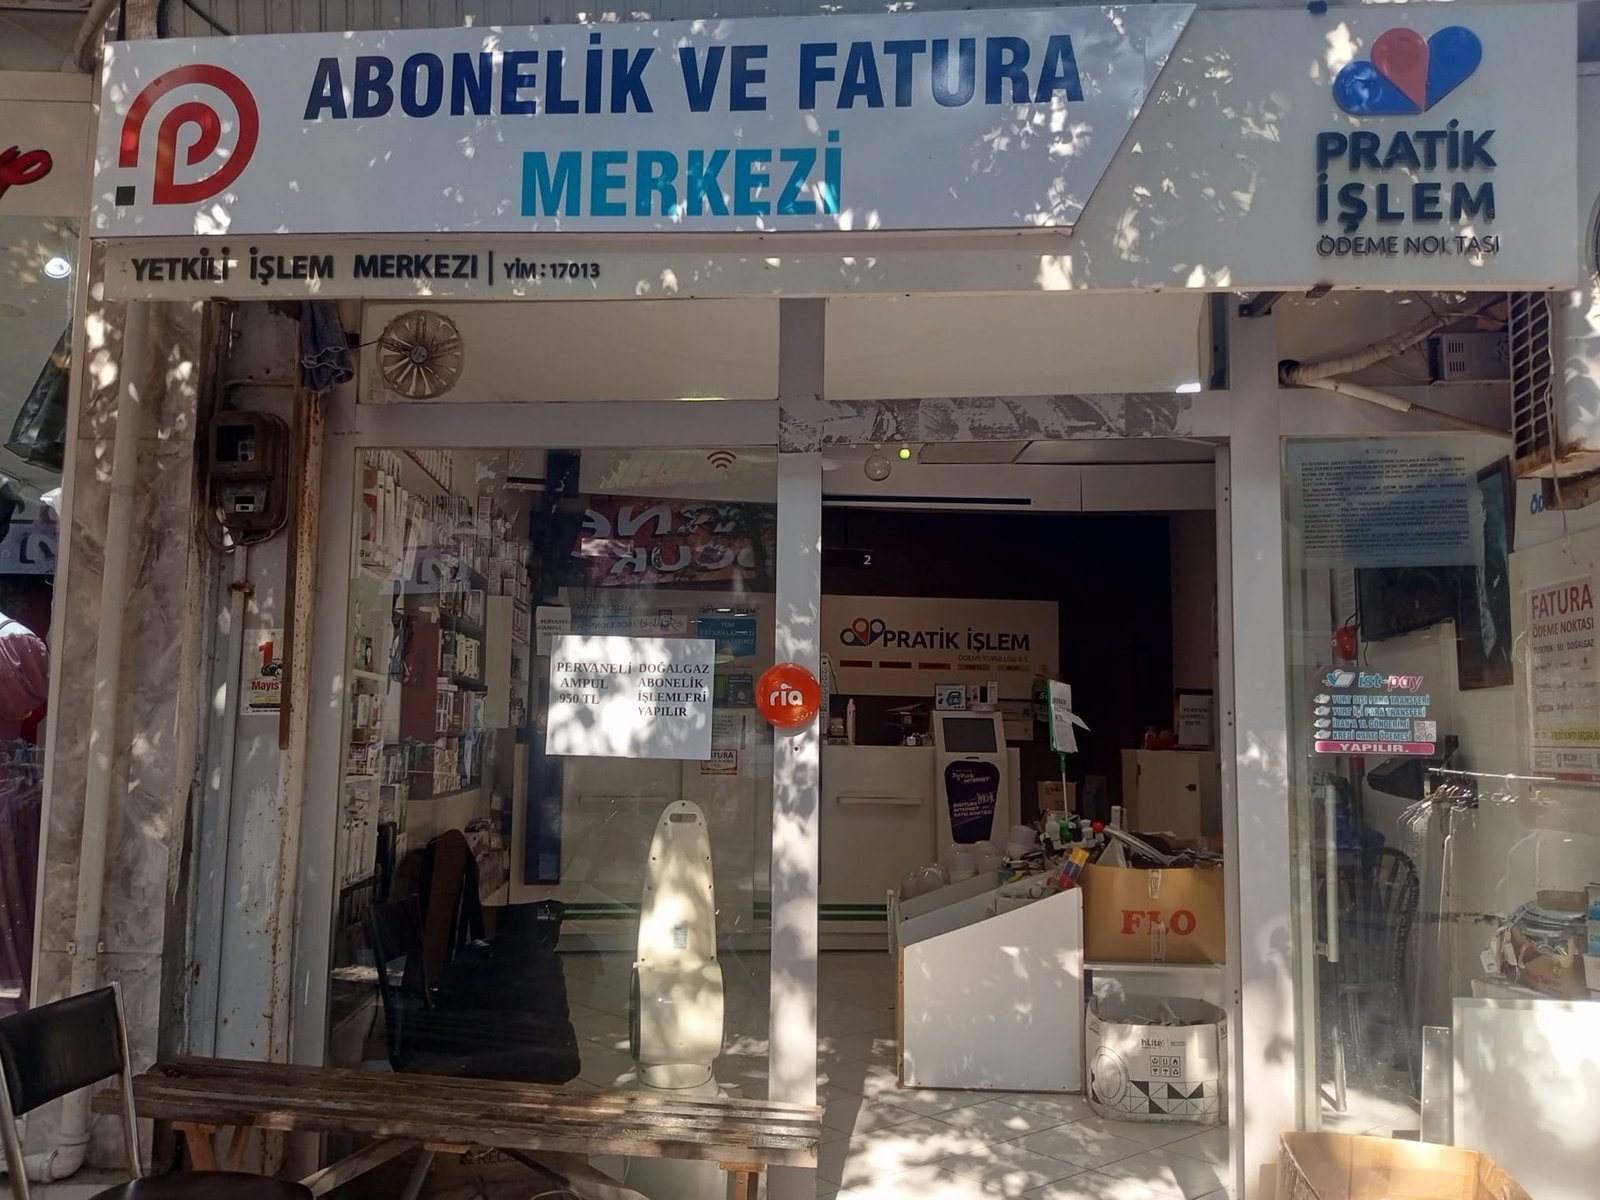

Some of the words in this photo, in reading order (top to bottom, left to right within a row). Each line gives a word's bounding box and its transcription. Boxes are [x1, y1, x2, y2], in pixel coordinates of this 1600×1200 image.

[303, 33, 655, 120] ABONELİK
[679, 45, 768, 112] VE
[799, 34, 1085, 111] FATURA
[1316, 119, 1497, 170] PRATİK
[520, 130, 842, 217] MERKEZİ
[1316, 173, 1496, 233] İŞLEM
[1316, 235, 1399, 257] ÖDEME
[131, 247, 231, 282] YETKİLİ
[249, 247, 334, 285] İŞLEM
[863, 555, 871, 565] 2
[1532, 584, 1593, 620] FATURA
[1532, 622, 1559, 638] ÖDEME
[1560, 617, 1594, 634] NOKTASI
[883, 627, 960, 650] PRATİK
[967, 627, 1030, 653] İŞLEM
[258, 641, 273, 666] 1
[556, 661, 632, 675] PERVANELİ
[638, 662, 710, 674] DOĞALGAZ
[560, 677, 609, 689] AMPUL
[637, 676, 704, 688] ABONELİK
[559, 693, 579, 704] 950
[582, 693, 600, 704] TL
[637, 690, 707, 704] İŞLEMLERİ
[769, 683, 803, 706] ria
[637, 706, 688, 717] YAPILIR
